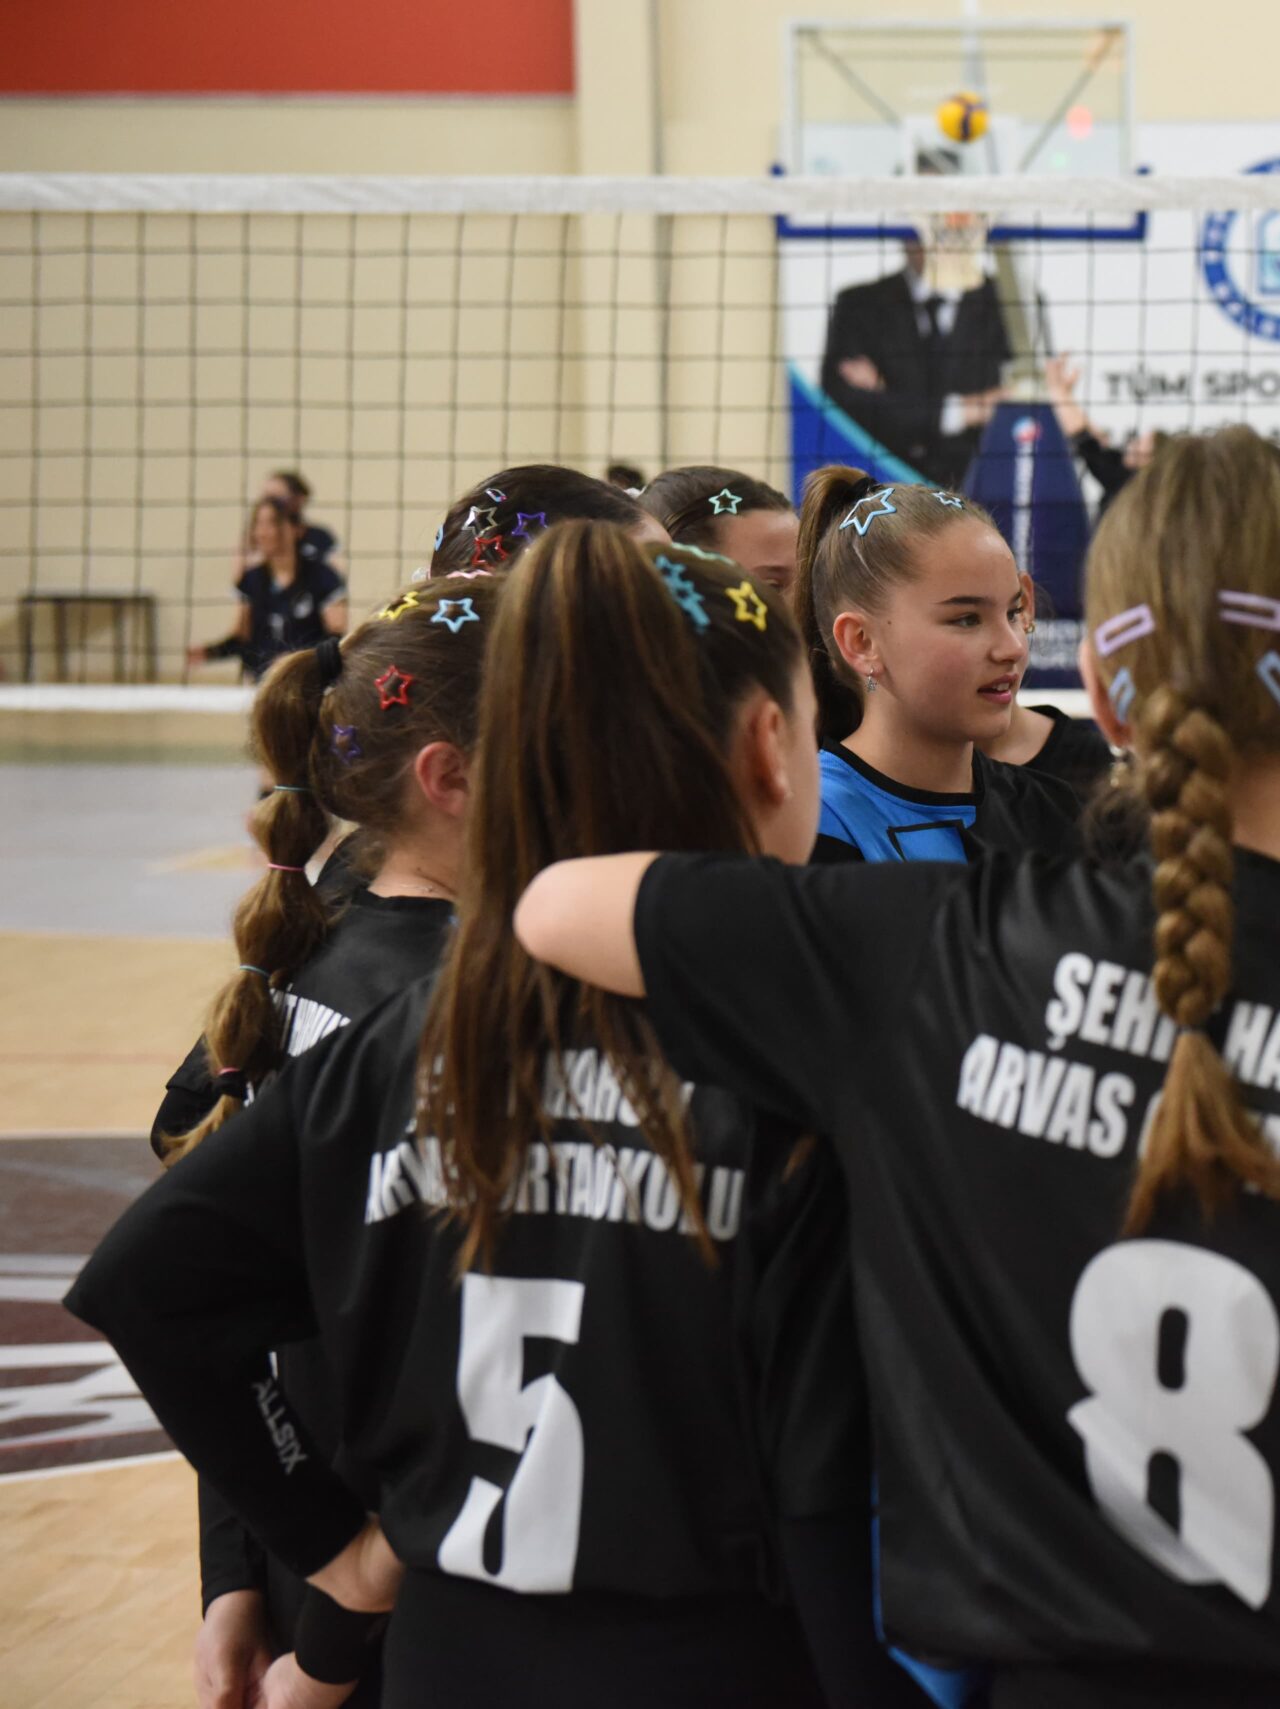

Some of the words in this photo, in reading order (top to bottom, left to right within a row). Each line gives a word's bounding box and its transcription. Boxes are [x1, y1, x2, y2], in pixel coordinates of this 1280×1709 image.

[1105, 364, 1188, 396] TÜM
[1044, 951, 1180, 1064] ŞEH
[956, 1033, 1135, 1159] ARVAS
[438, 1272, 585, 1595] 5
